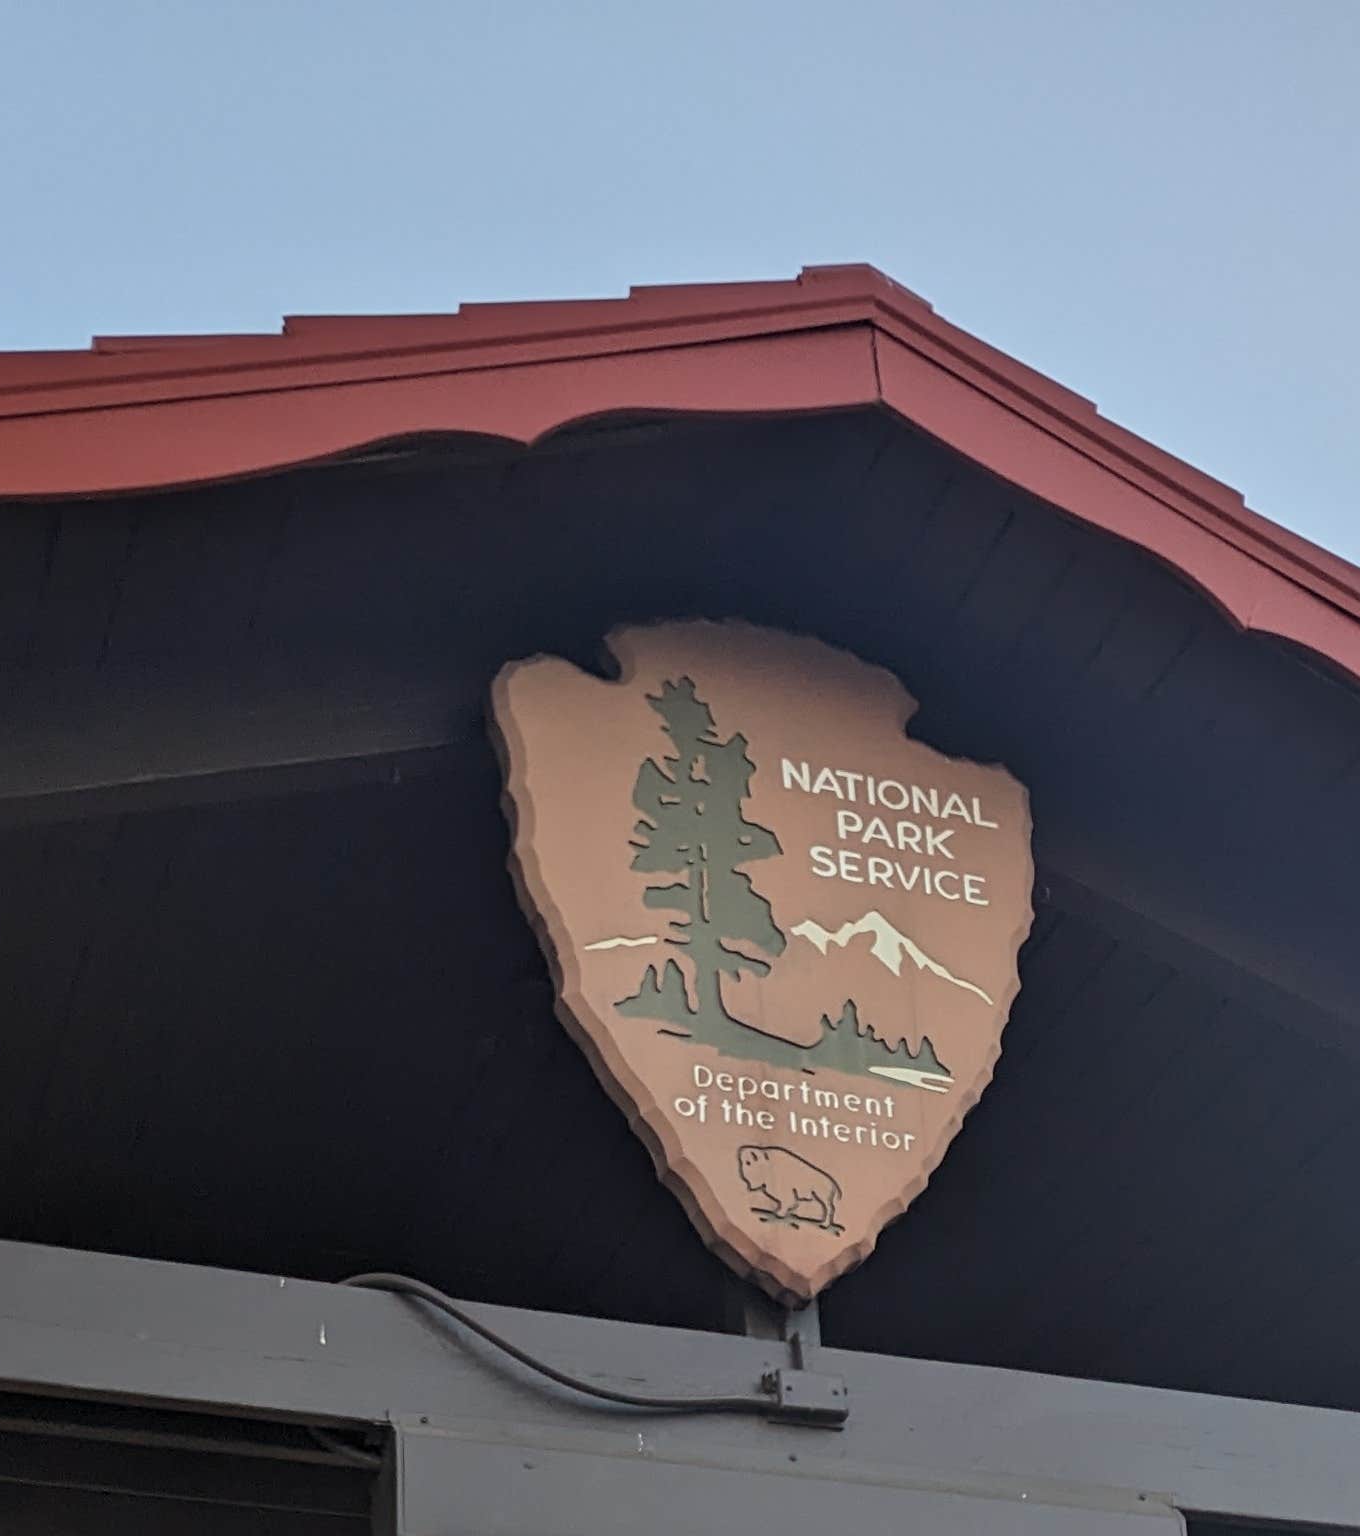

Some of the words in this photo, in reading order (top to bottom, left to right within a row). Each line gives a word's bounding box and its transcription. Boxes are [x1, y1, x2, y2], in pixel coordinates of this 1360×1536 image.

[781, 758, 998, 829] NATIONAL
[837, 811, 954, 859] PARK
[811, 846, 989, 905] SERVICE
[693, 1065, 895, 1118] Department
[674, 1095, 707, 1117] of
[721, 1101, 775, 1129] the
[789, 1111, 916, 1151] Interior
